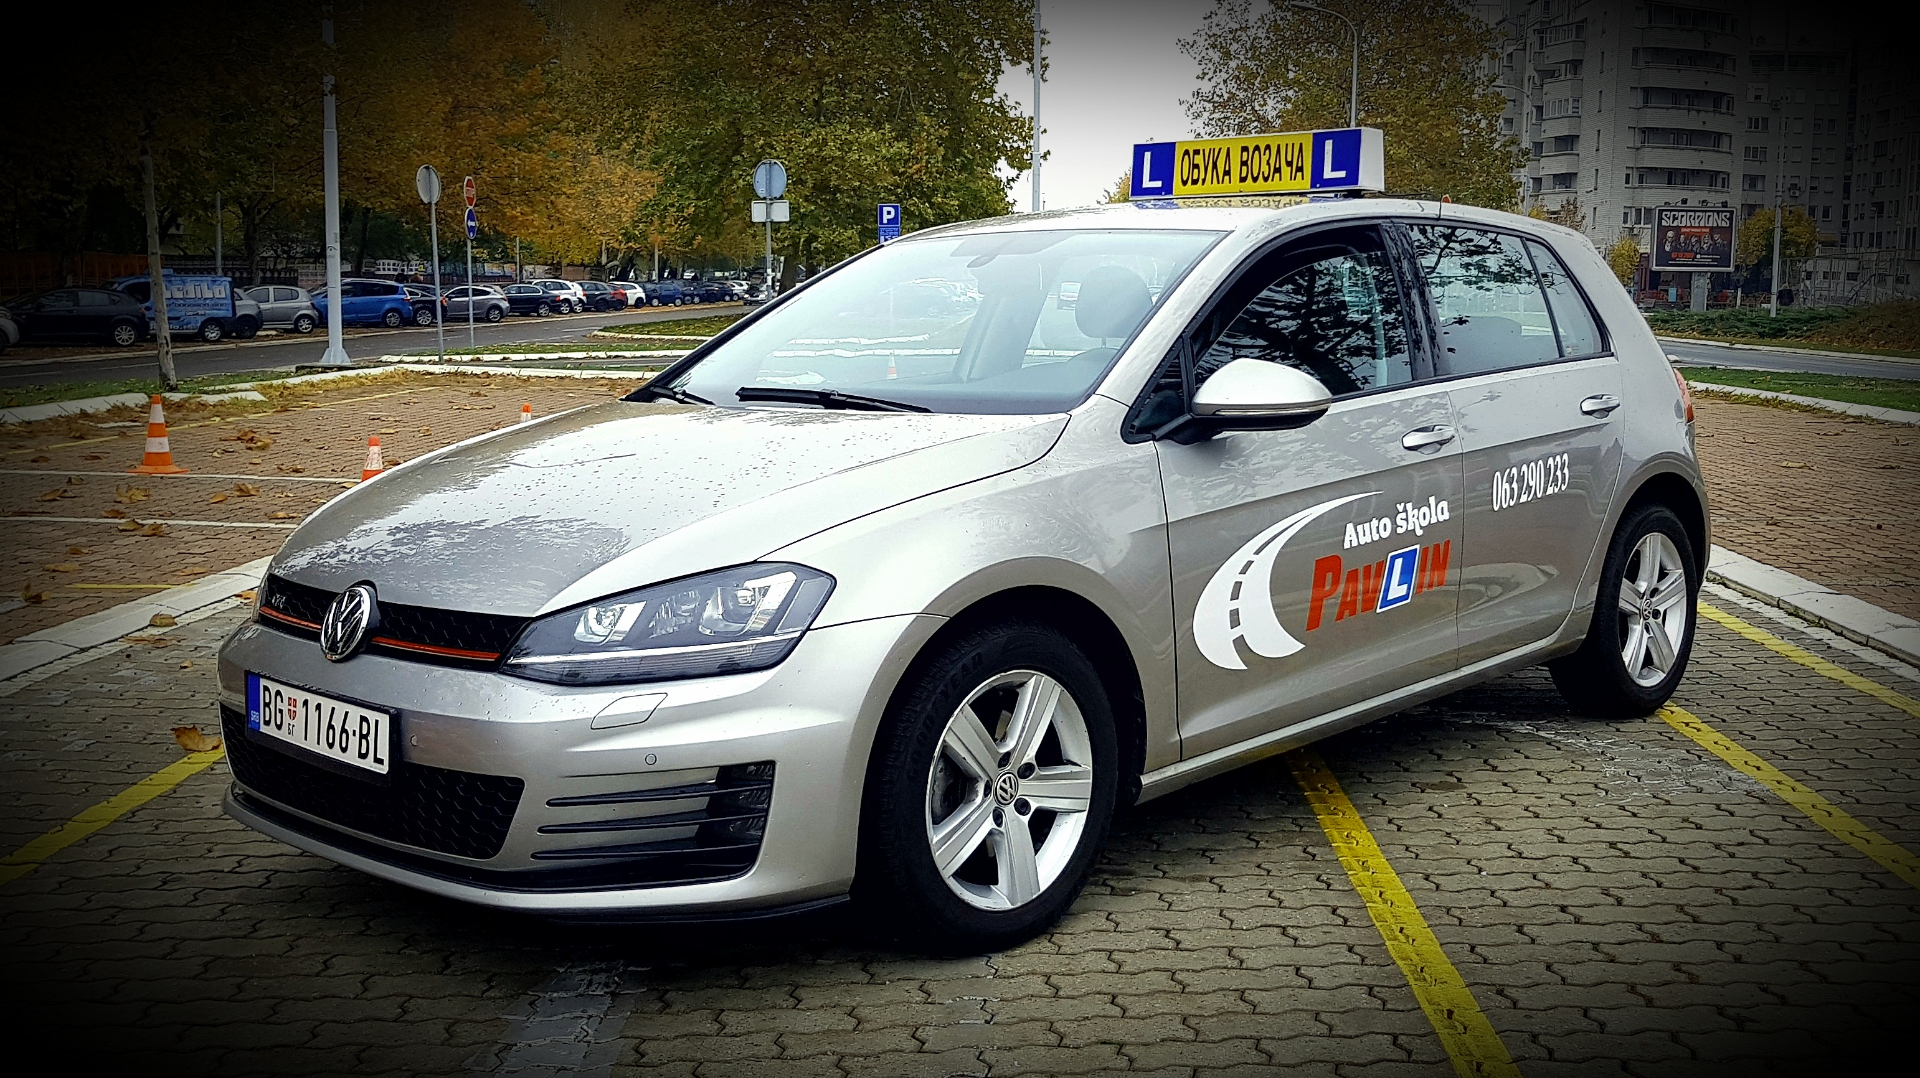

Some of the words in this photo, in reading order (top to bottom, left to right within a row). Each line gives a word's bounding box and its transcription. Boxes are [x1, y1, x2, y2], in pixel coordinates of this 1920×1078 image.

[1142, 151, 1162, 188] L
[1180, 147, 1232, 187] ОБУКА
[1239, 142, 1305, 184] ВОЗАЧА
[1323, 139, 1347, 179] L
[882, 206, 896, 224] P
[1661, 211, 1730, 227] SCORPIONS
[1492, 466, 1518, 511] 063
[1519, 459, 1544, 504] 290
[1545, 452, 1570, 496] 233
[1343, 516, 1391, 549] Auto
[1396, 496, 1450, 536] škola
[1305, 540, 1451, 632] PAVLIN
[263, 684, 284, 731] BG
